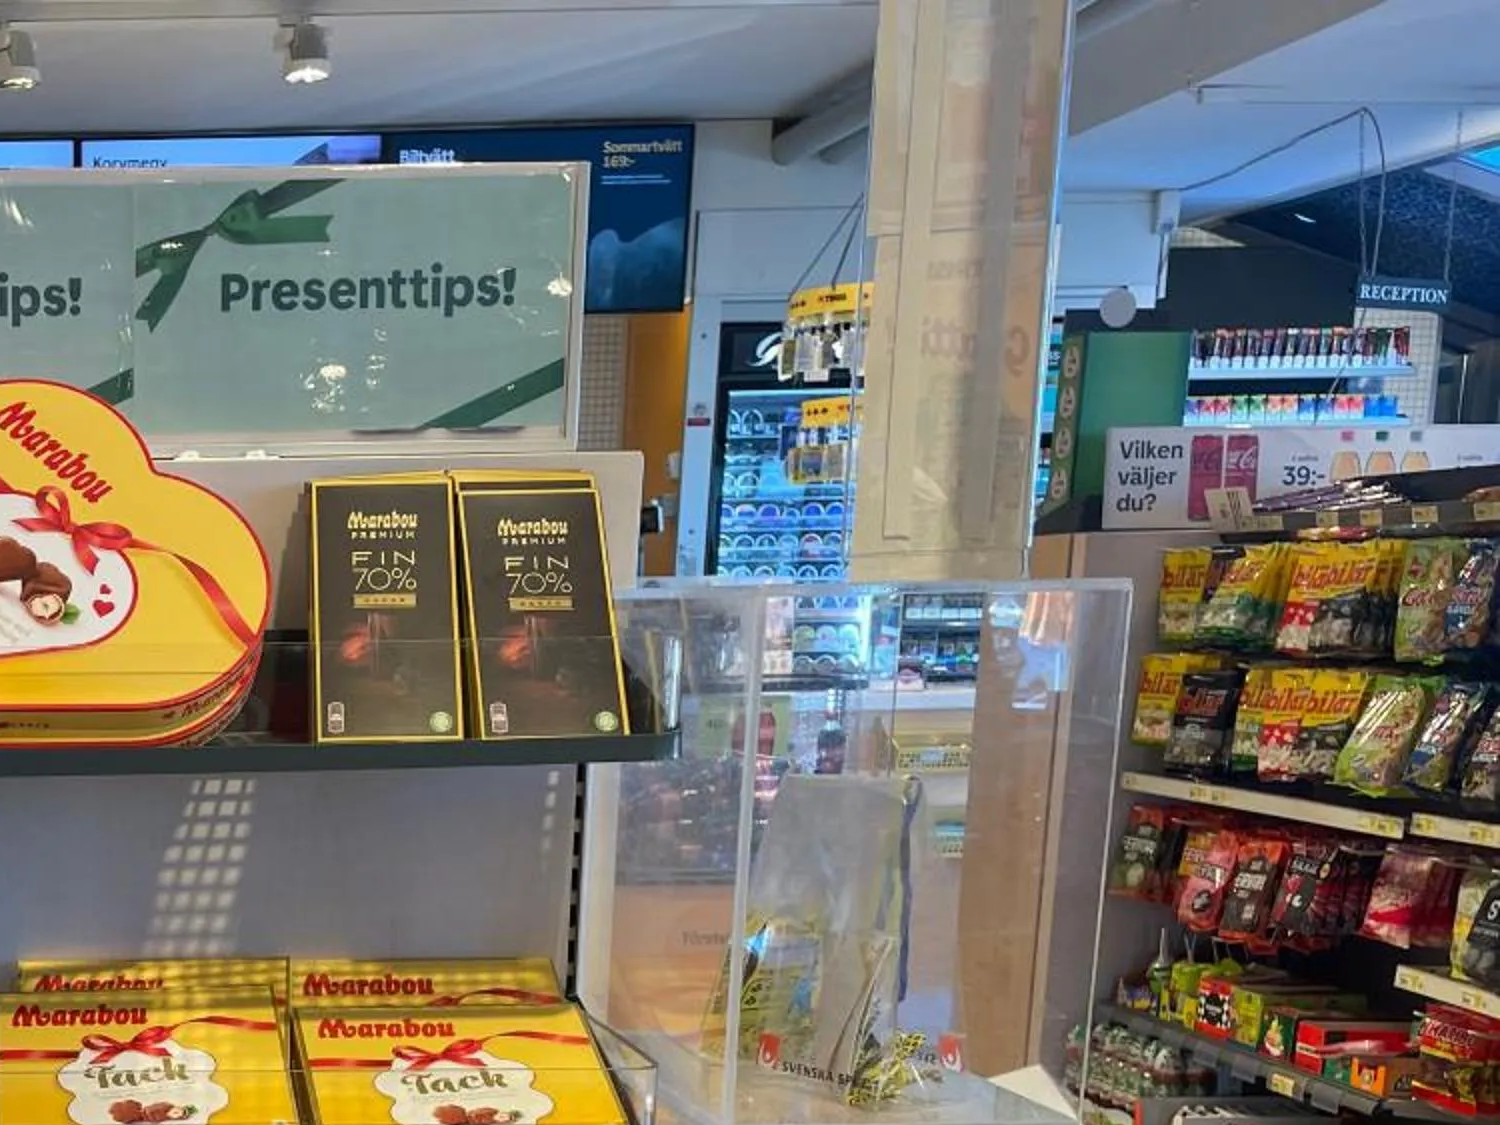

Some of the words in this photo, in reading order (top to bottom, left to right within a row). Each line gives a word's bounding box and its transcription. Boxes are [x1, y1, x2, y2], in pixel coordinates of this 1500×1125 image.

[220, 262, 517, 316] Presenttips!
[1359, 283, 1448, 304] RECEPTION
[1119, 440, 1183, 459] Vilken
[1117, 467, 1177, 494] väljer
[1282, 465, 1325, 486] 39:-
[1116, 493, 1156, 512] du?
[347, 509, 418, 530] Marabou
[497, 517, 569, 538] Marabou
[351, 531, 415, 539] PREMIUM
[351, 550, 415, 566] FIN
[504, 556, 569, 571] FIN
[352, 566, 417, 591] 70%
[505, 572, 573, 594] 70%
[303, 972, 435, 997] Marabou
[12, 1003, 148, 1028] Marabou
[318, 1017, 455, 1038] Marabou
[83, 1057, 189, 1089] Tack
[402, 1069, 509, 1095] Tack
[782, 1061, 834, 1083] SVENSKA
